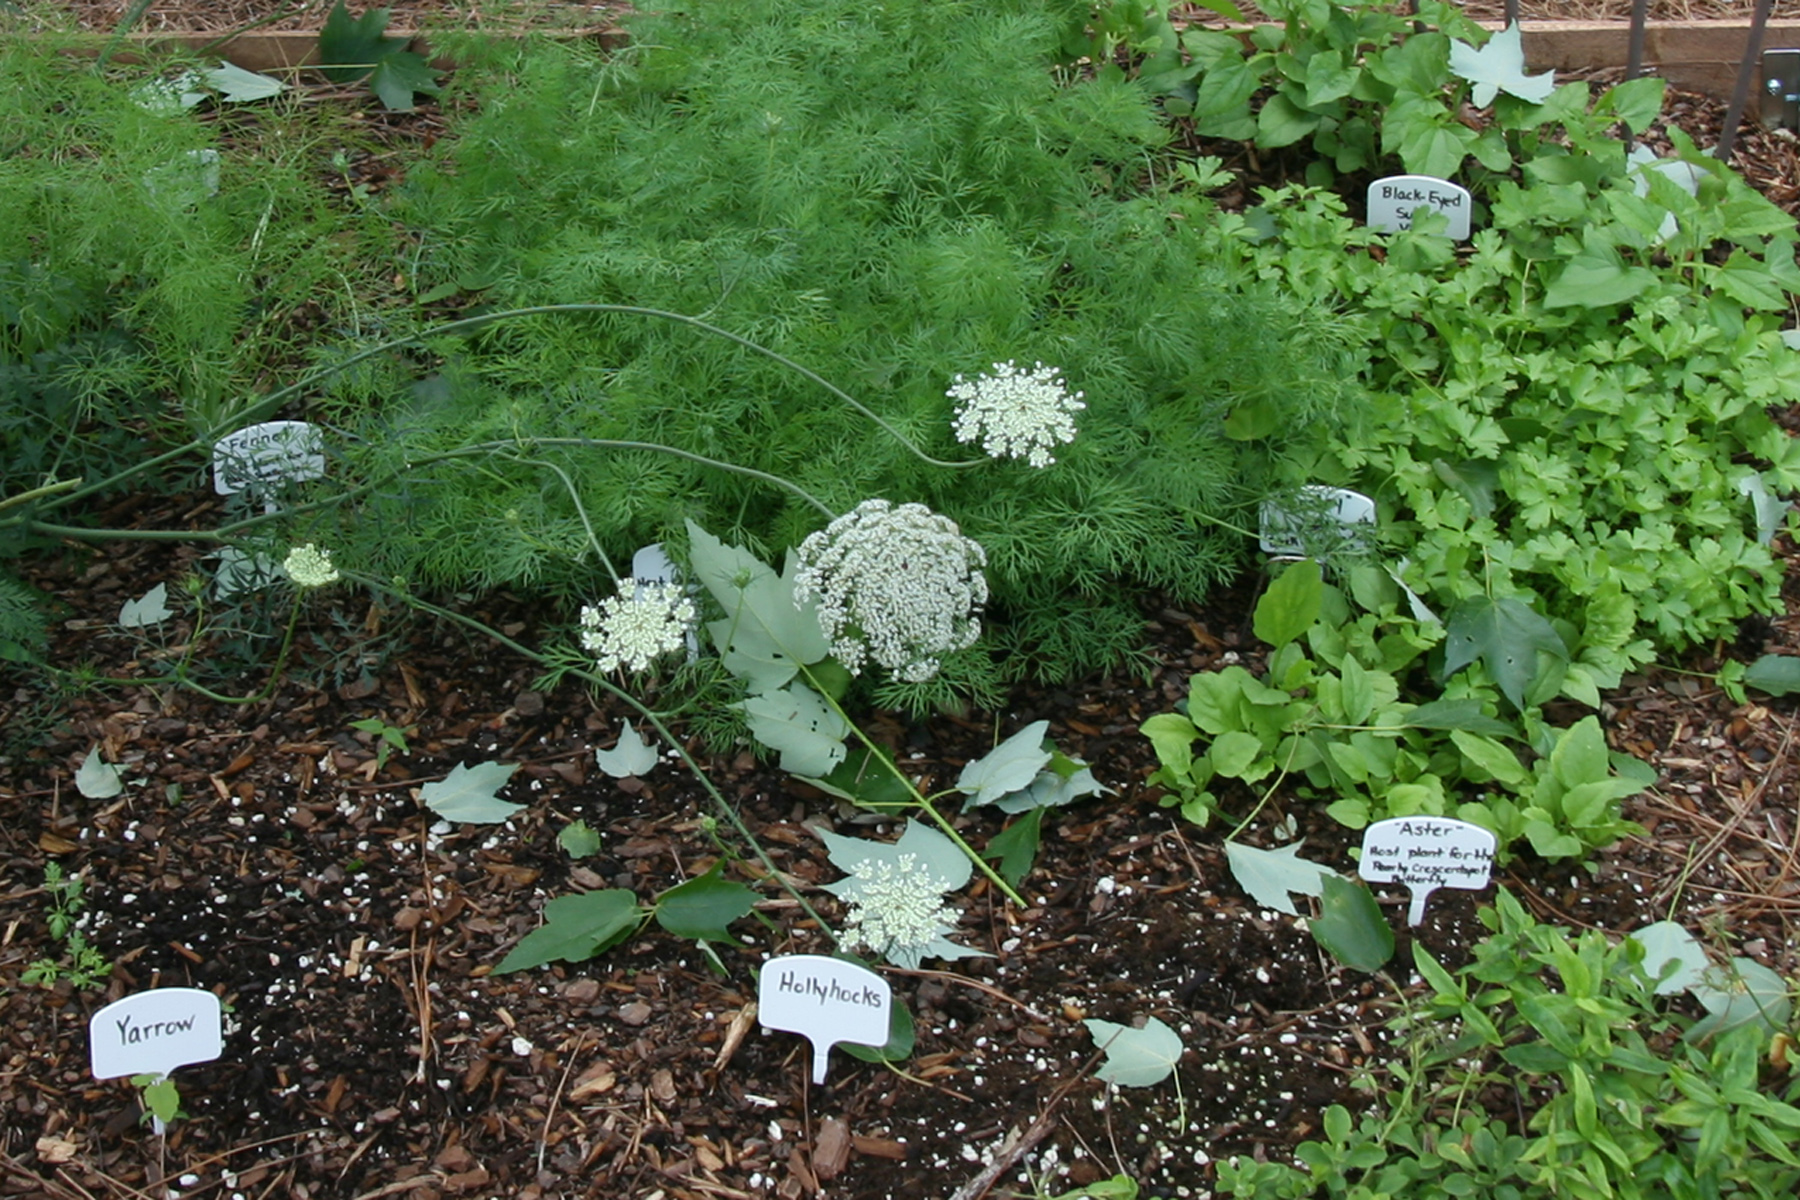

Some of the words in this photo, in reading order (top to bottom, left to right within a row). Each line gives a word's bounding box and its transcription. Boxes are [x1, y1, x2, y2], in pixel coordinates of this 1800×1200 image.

[1369, 845, 1400, 856] Host
[1407, 846, 1444, 859] plant
[1448, 846, 1472, 860] for
[778, 970, 882, 1008] Hollyhocks
[116, 1014, 196, 1046] Yarrow
